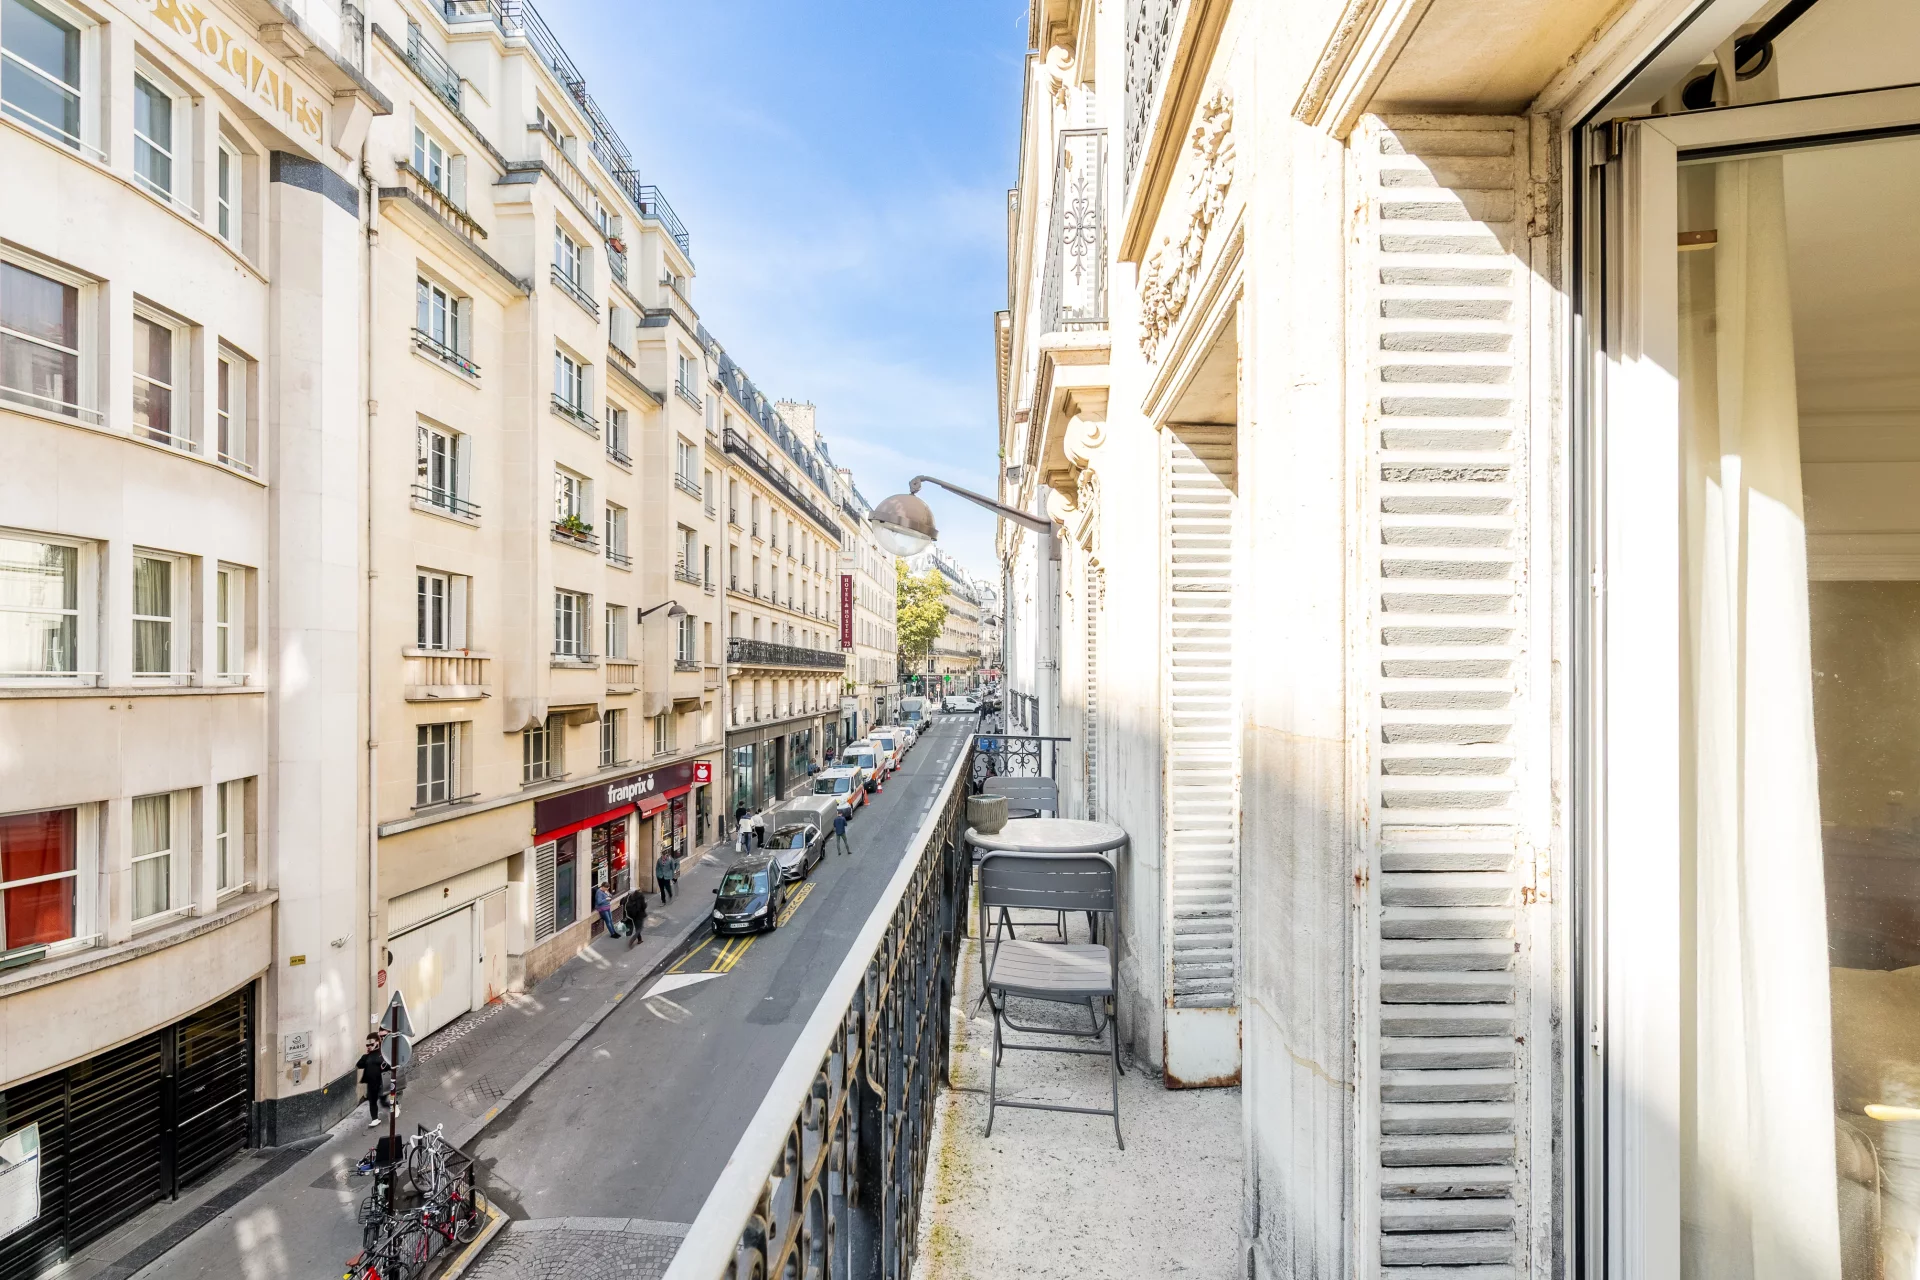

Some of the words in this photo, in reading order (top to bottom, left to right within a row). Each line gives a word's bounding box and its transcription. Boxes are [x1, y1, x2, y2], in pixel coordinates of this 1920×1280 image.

[173, 0, 322, 145] SOCIALES
[607, 776, 647, 804] franprix
[289, 1043, 306, 1051] PARIS
